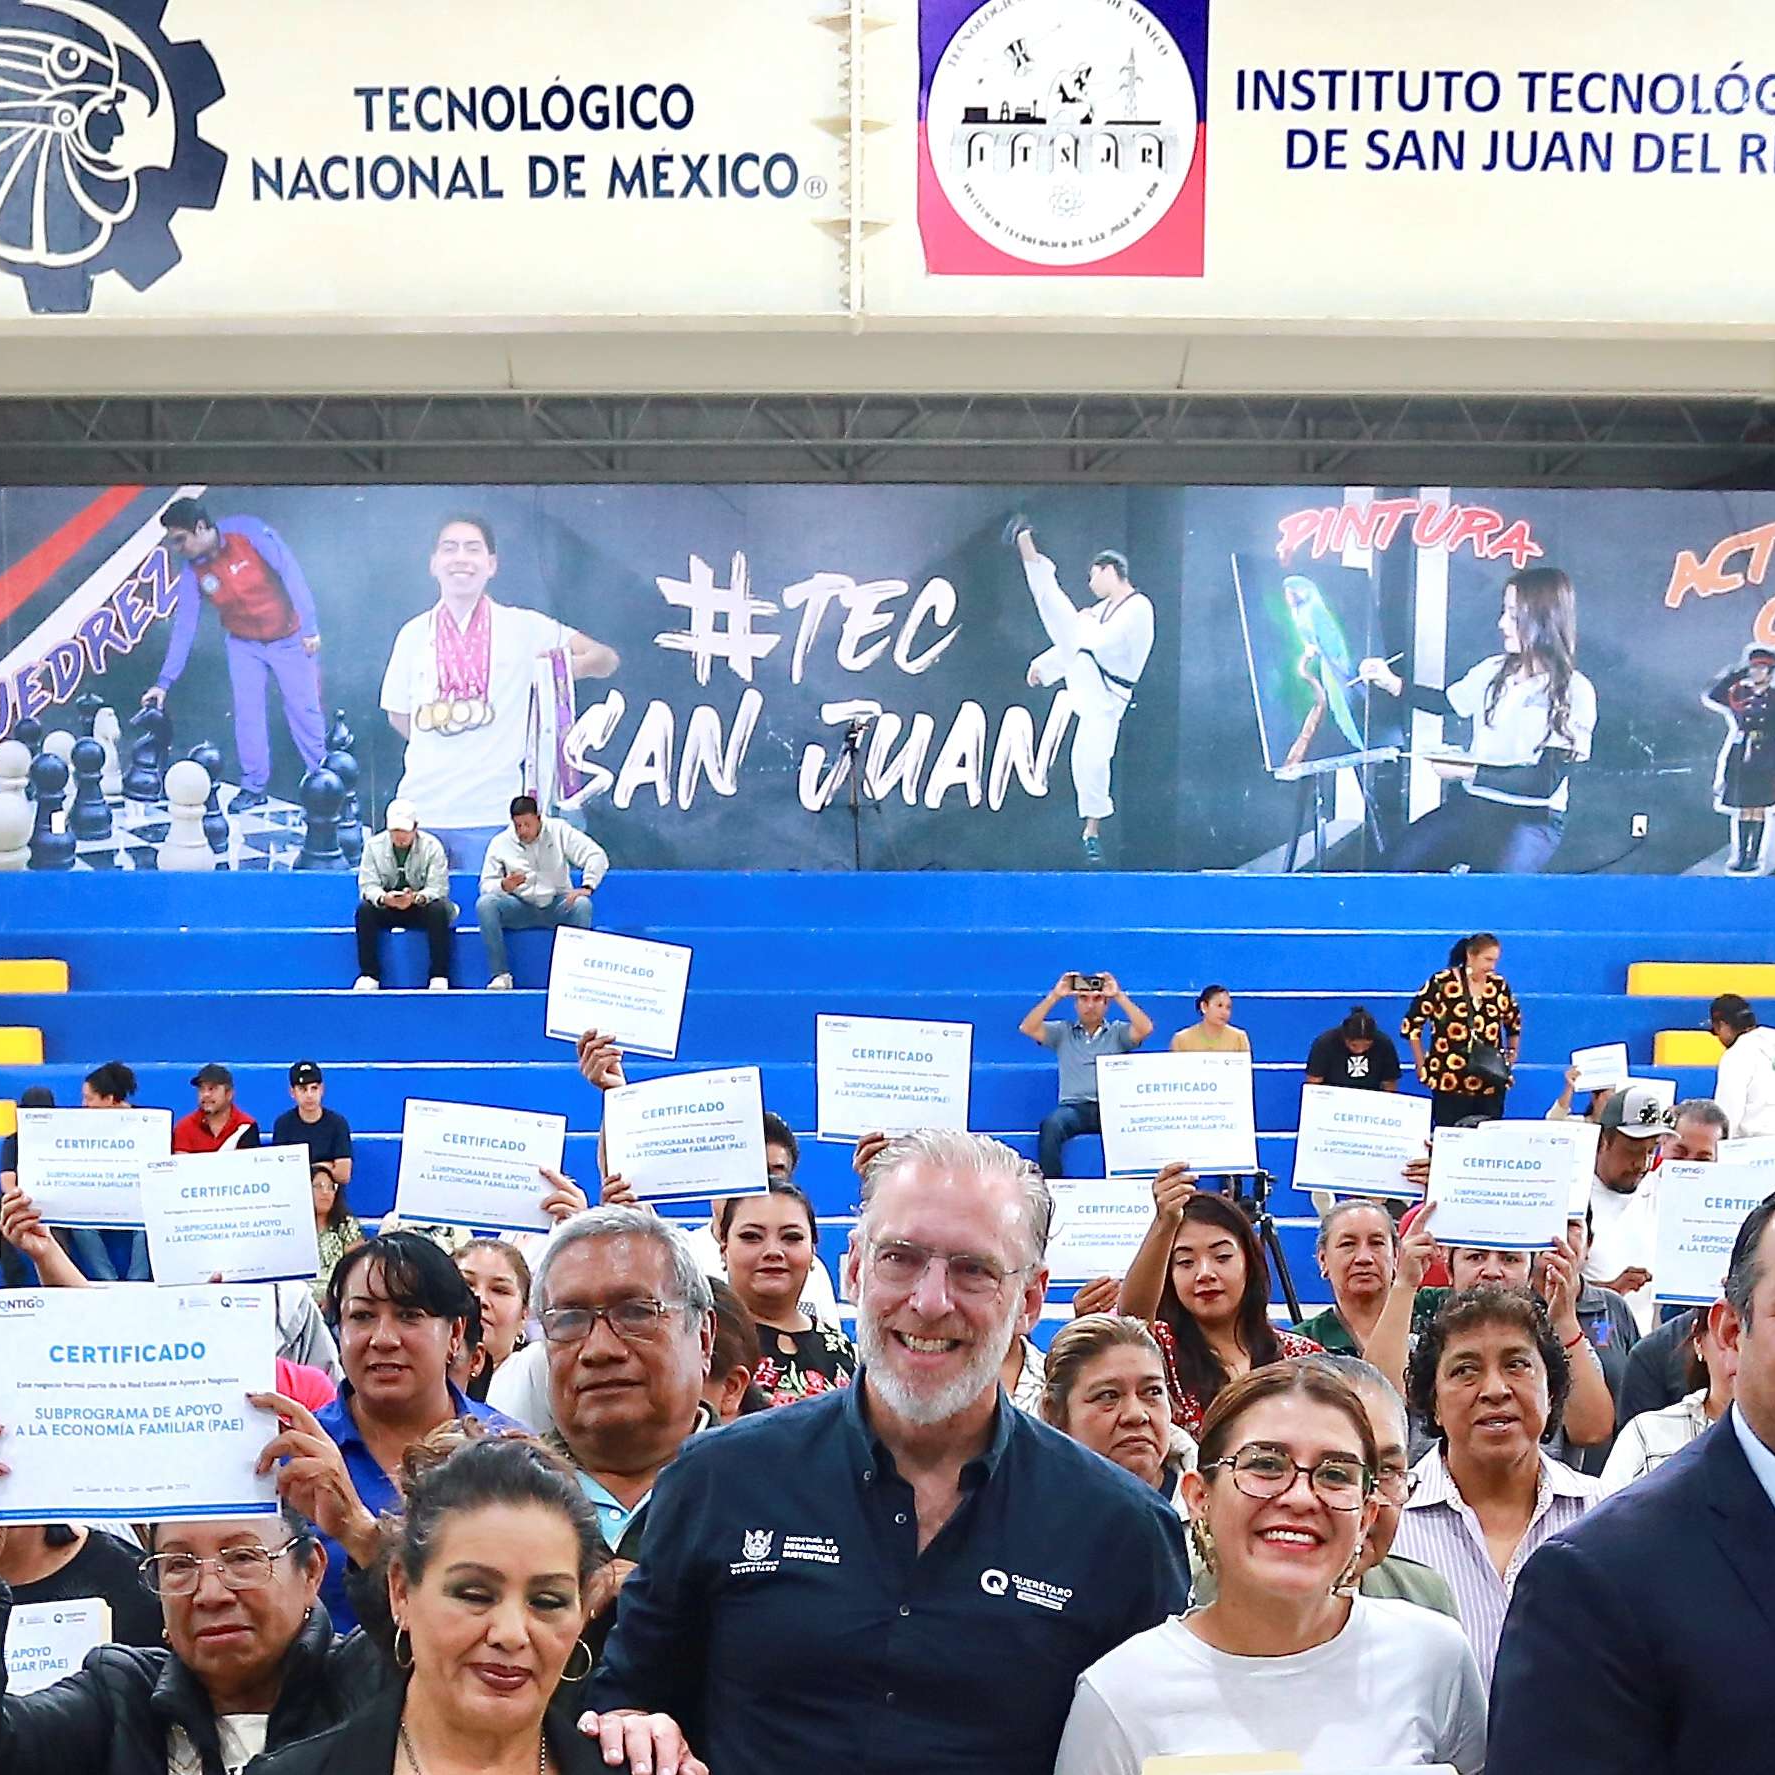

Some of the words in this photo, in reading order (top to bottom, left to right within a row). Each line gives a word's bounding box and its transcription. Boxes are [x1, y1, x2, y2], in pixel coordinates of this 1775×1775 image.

[1235, 69, 1501, 113] INSTITUTO
[354, 75, 694, 132] TECNOLÓGICO
[1285, 129, 1347, 170] DE
[1365, 129, 1465, 172] SAN
[1481, 130, 1613, 173] JUAN
[1633, 132, 1721, 173] DEL
[251, 154, 503, 201] NACIONAL
[529, 153, 586, 199] DE
[607, 147, 798, 200] MÉXICO
[1277, 498, 1543, 569] PINTURA
[653, 549, 963, 687] #TEC
[565, 687, 763, 811] SAN
[796, 689, 1082, 814] JUAN
[583, 957, 655, 978] CERTIFICADO
[851, 1048, 934, 1064] CERTIFICADO
[1135, 1082, 1218, 1094] CERTIFICADO
[641, 1100, 725, 1120] CERTIFICADO
[1333, 1112, 1403, 1128] CERTIFICADO
[55, 1138, 135, 1150] CERTIFICADO
[442, 1132, 527, 1152] CERTIFICADO
[1462, 1156, 1543, 1170] CERTIFICADO
[180, 1182, 271, 1200] CERTIFICADO
[49, 1341, 206, 1364] CERTIFICADO
[35, 1406, 148, 1420] SUBPROGRAMA
[153, 1407, 171, 1418] DE
[175, 1404, 223, 1416] APOYO
[16, 1425, 26, 1436] A
[29, 1425, 47, 1436] LA
[53, 1422, 135, 1436] ECONOMÍA
[139, 1422, 204, 1434] FAMILIAR
[208, 1419, 244, 1433] (PAE)
[1011, 1574, 1073, 1598] QUERÉTARO
[12, 1647, 51, 1658] APOYO
[38, 1658, 68, 1671] (PAE)
